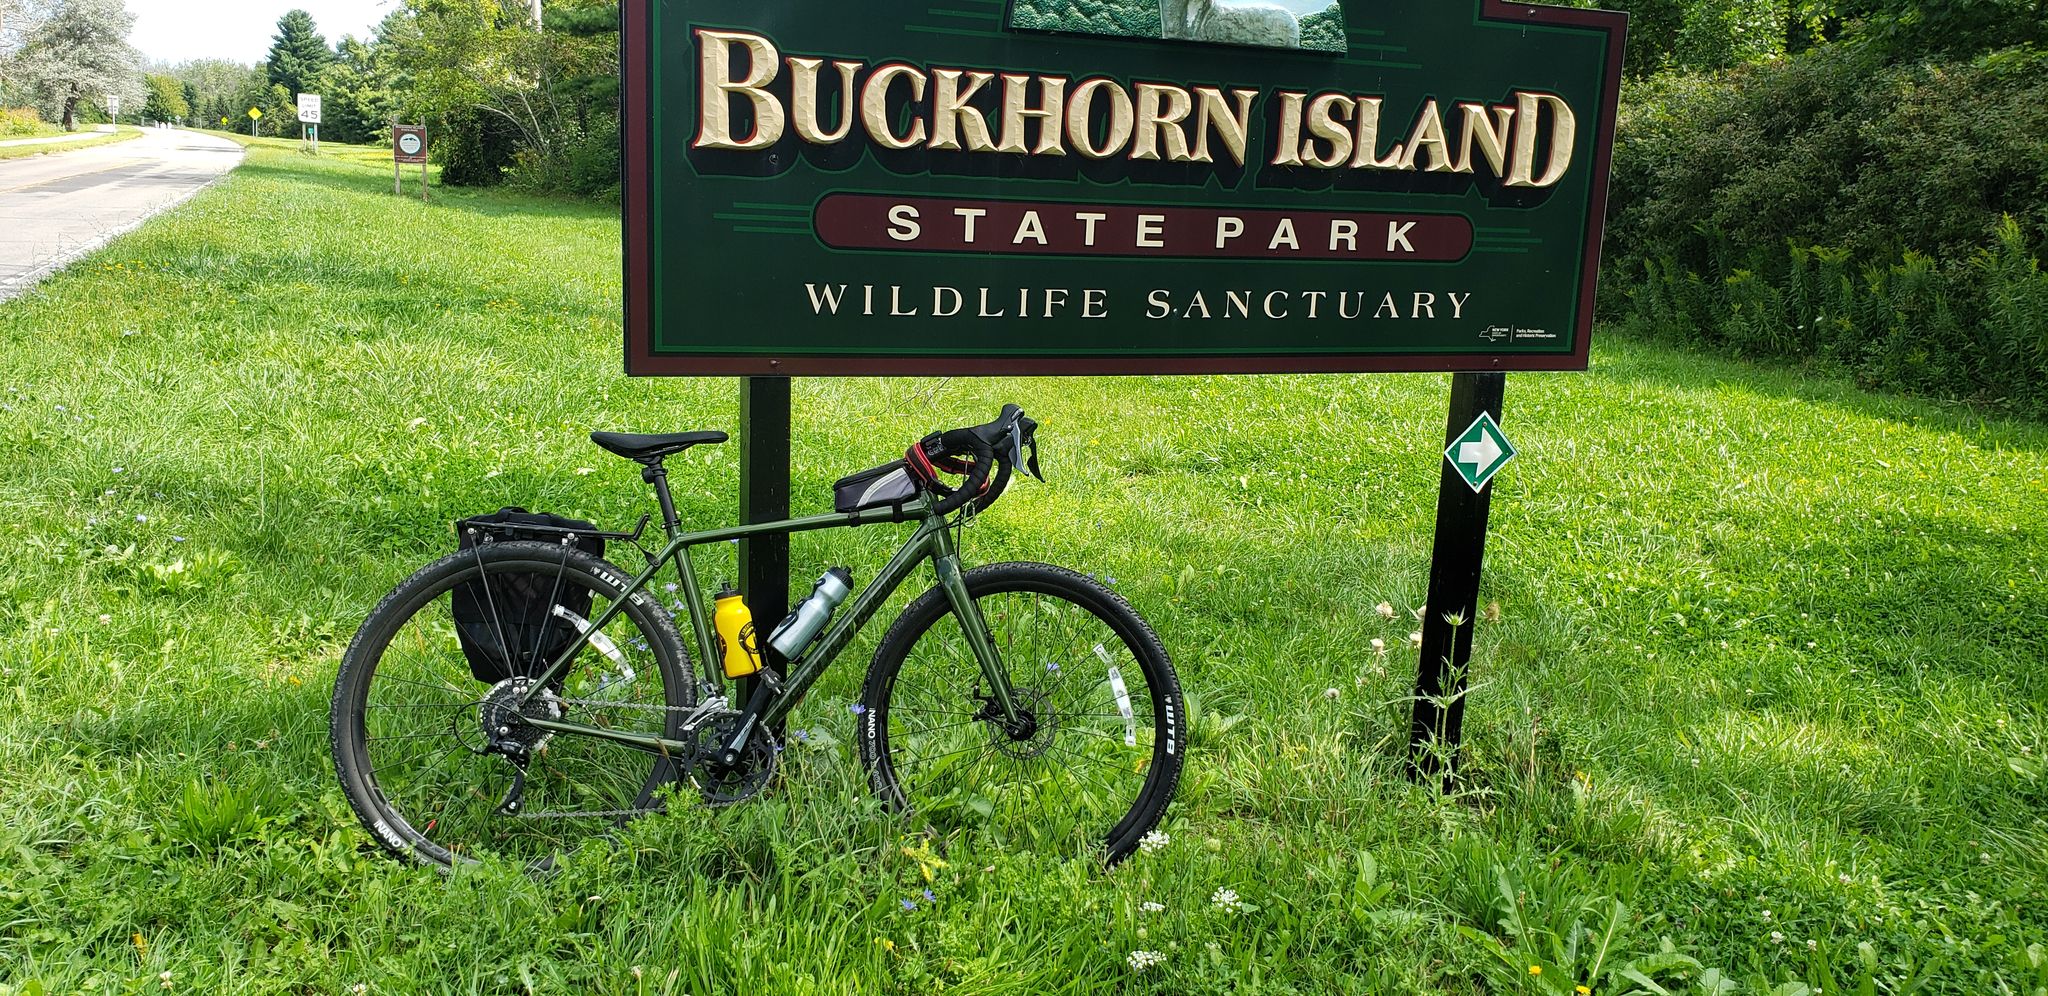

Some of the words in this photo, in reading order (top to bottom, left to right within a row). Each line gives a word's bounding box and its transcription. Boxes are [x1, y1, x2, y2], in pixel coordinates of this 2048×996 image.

[300, 110, 318, 119] 45
[692, 28, 1259, 167] BUCKHORN
[1272, 91, 1576, 188] ISLAND
[886, 204, 1166, 249] STATE
[1215, 215, 1417, 253] PARK
[804, 283, 1109, 319] WILDLIFE
[1146, 288, 1472, 320] SANCTUARY
[867, 707, 876, 739] NANO
[1165, 704, 1175, 755] WTB
[374, 819, 402, 848] NANO
